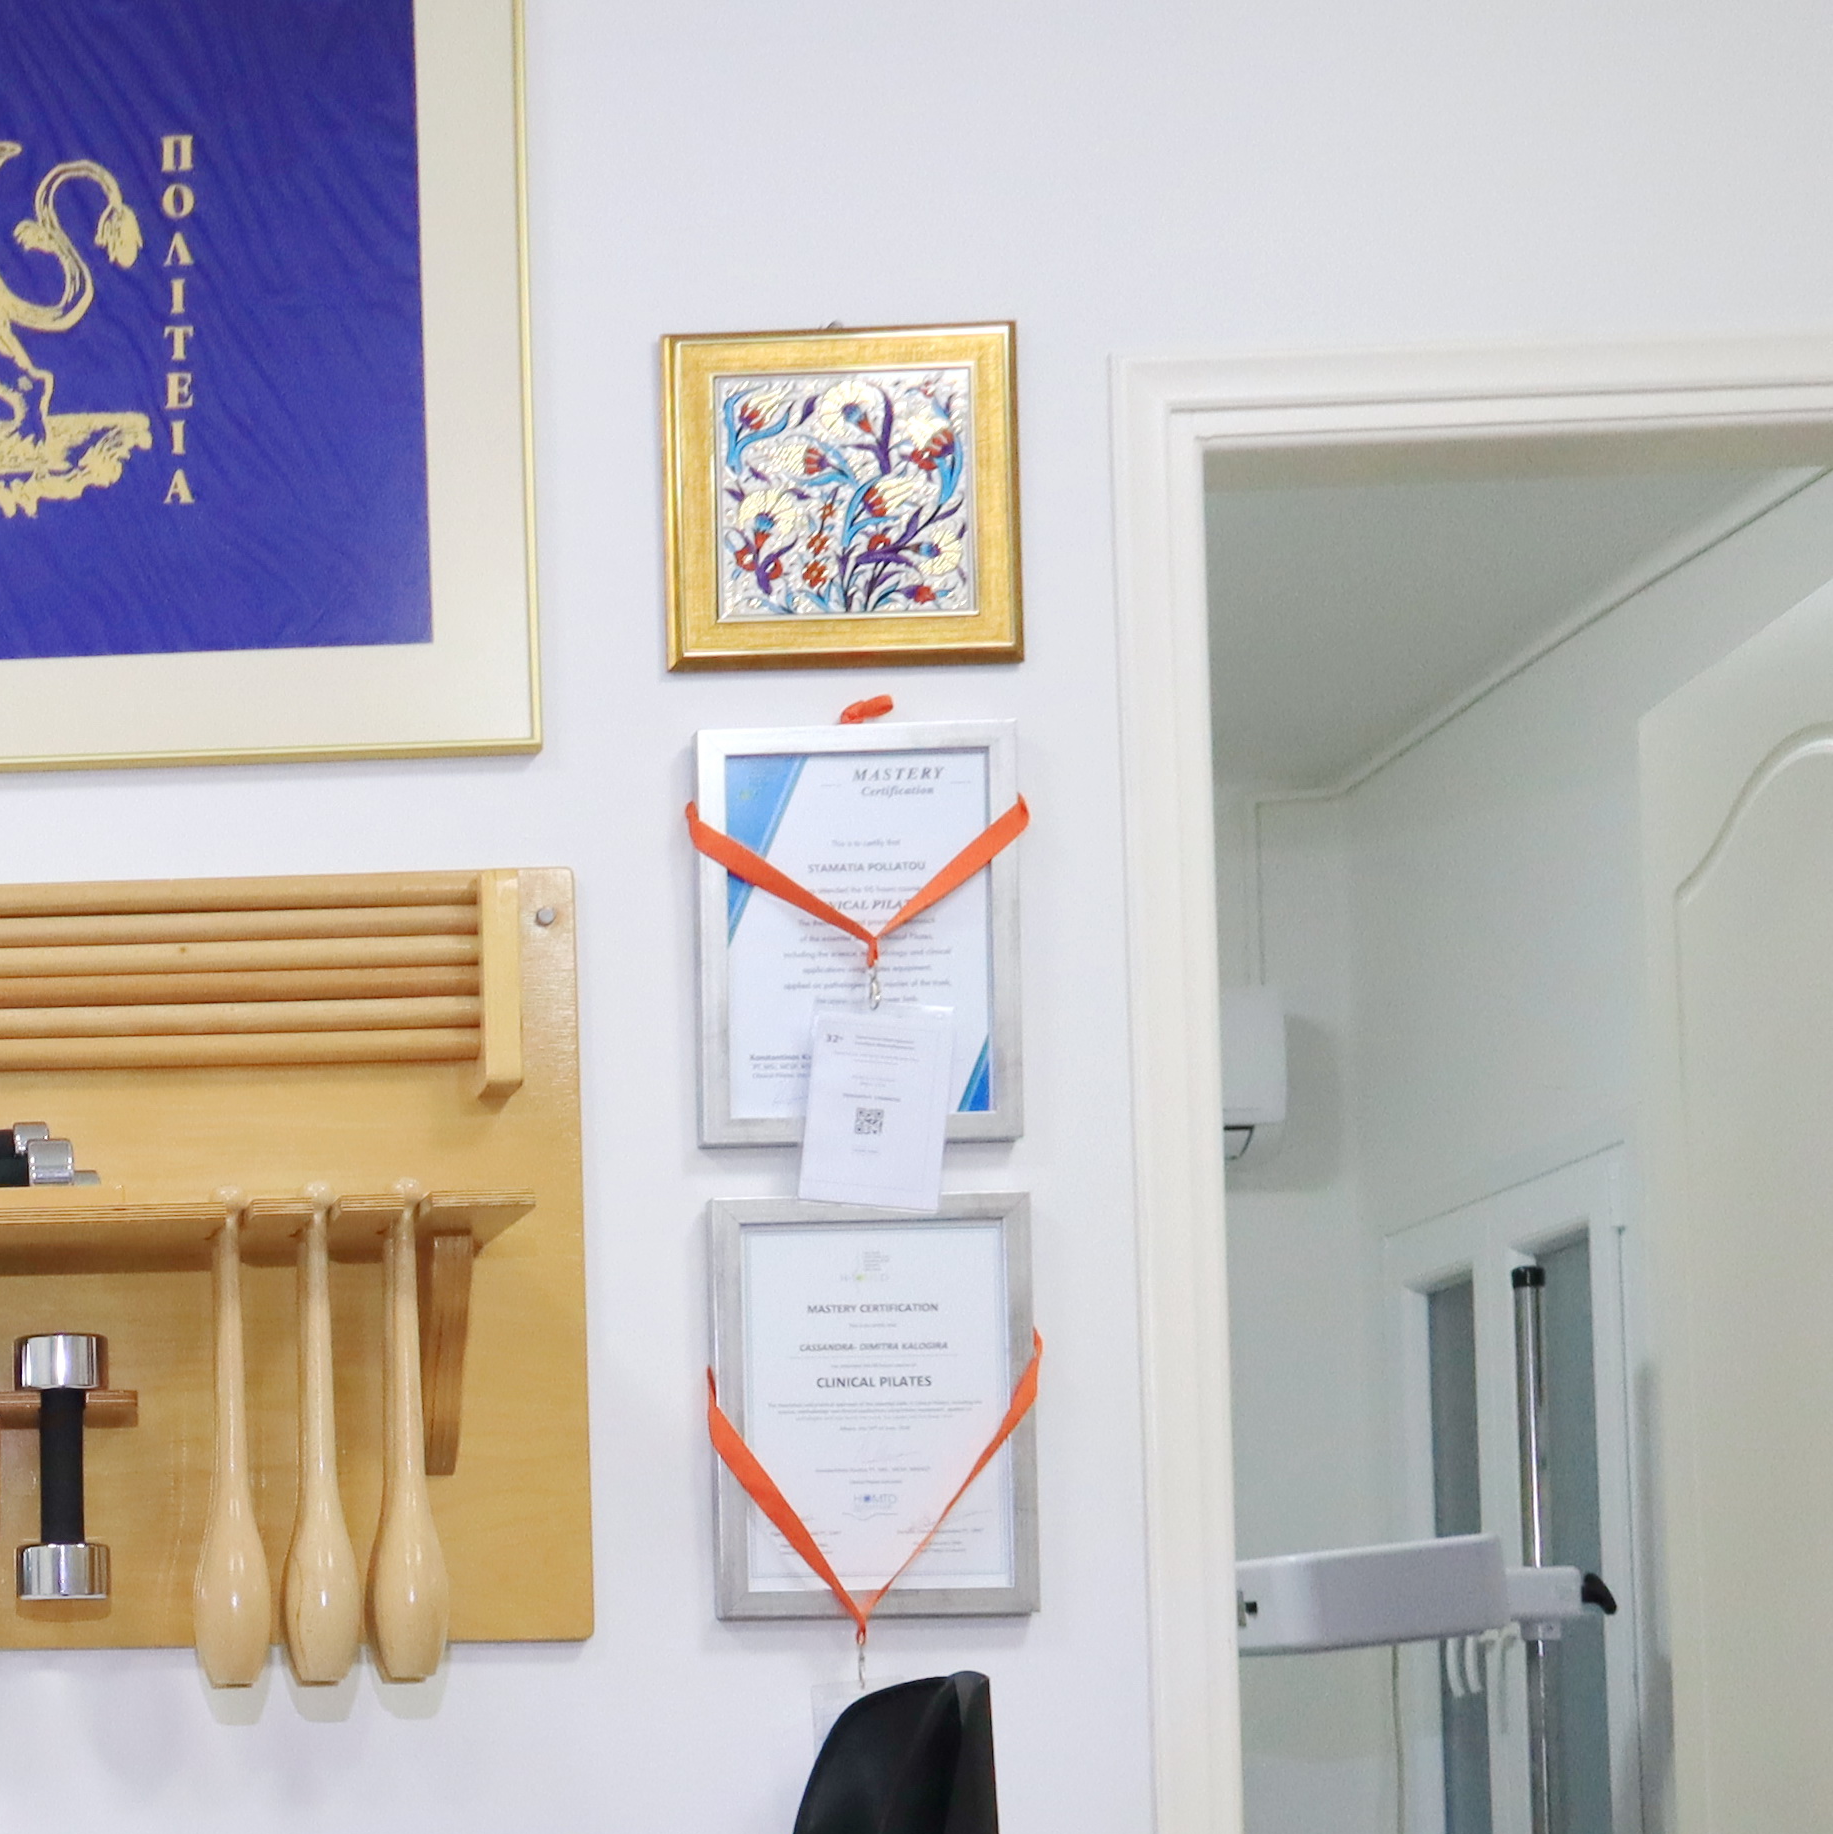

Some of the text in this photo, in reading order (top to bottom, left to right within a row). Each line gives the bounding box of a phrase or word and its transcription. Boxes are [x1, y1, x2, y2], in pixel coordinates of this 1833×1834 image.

[160, 133, 196, 505] ΠΟΛΙΤΕΙΑ
[852, 765, 945, 782] MASTERY
[860, 785, 934, 798] Certification
[807, 860, 927, 873] STAMATIA POLLATOU
[806, 1302, 939, 1314] MASTERY CERTIFICATION
[816, 1375, 933, 1388] CLINICAL PILATES
